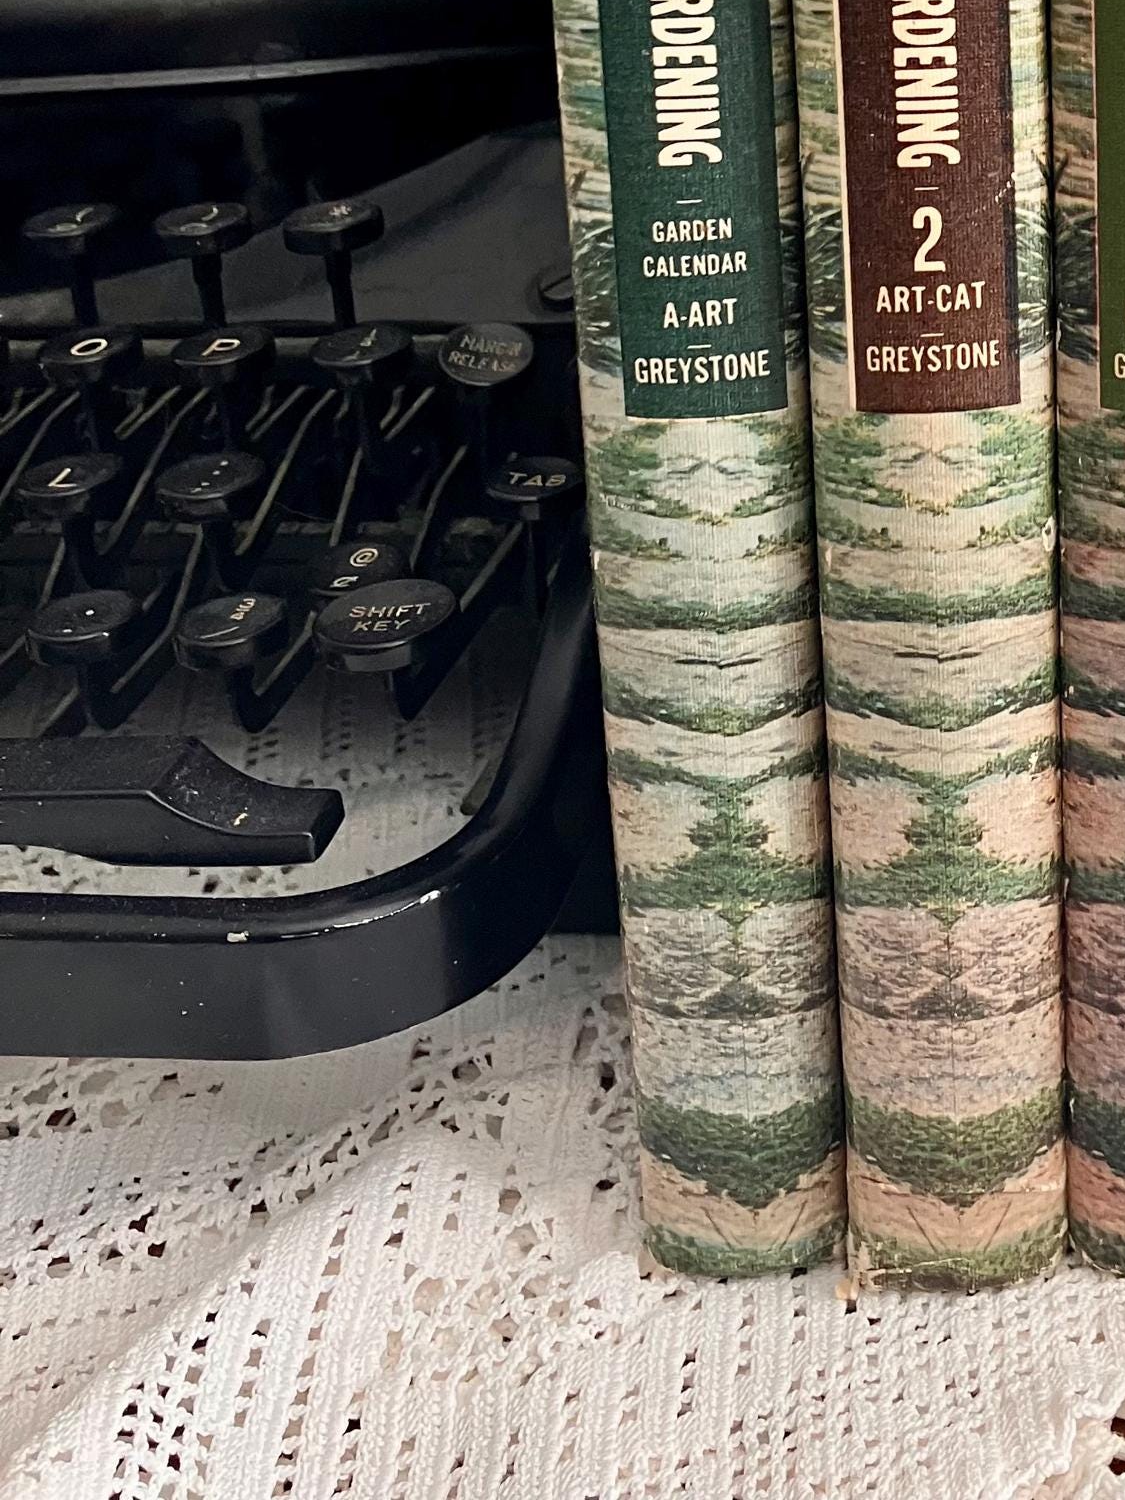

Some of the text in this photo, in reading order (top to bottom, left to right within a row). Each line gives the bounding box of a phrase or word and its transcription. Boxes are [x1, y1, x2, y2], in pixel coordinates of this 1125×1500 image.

[652, 217, 732, 243] GARDEN
[912, 206, 947, 272] 2
[643, 250, 747, 278] CALENDAR
[876, 280, 986, 313] ART-CAT
[663, 297, 738, 329] A-ART
[69, 338, 109, 357] O
[201, 337, 241, 357] P
[866, 339, 1000, 373] GREYSTONE
[634, 350, 771, 384] GREYSTONE
[47, 467, 77, 488] L
[508, 471, 567, 488] TAB
[349, 602, 432, 619] SHIFT
[351, 619, 412, 633] KEY
